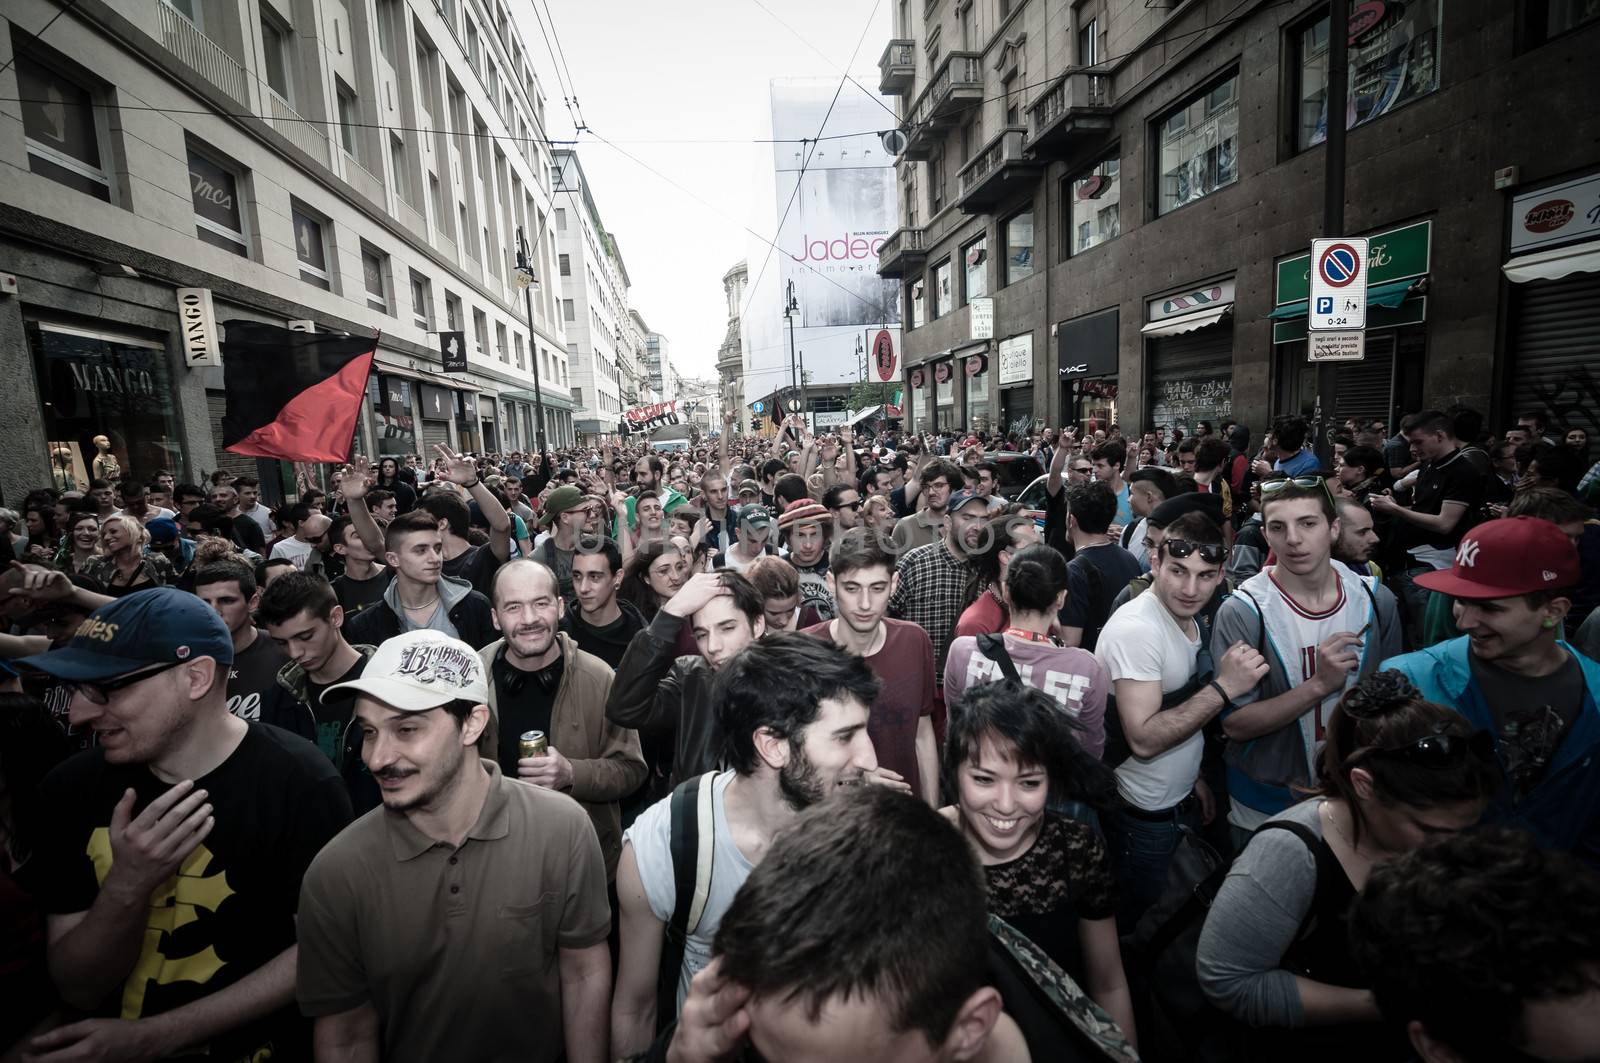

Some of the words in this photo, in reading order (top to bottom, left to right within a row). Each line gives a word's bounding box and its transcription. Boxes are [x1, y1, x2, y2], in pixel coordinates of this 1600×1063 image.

[1320, 299, 1330, 313] P
[183, 294, 208, 361] MANGO
[70, 362, 153, 395] MANGO
[624, 400, 677, 422] OCCUPY
